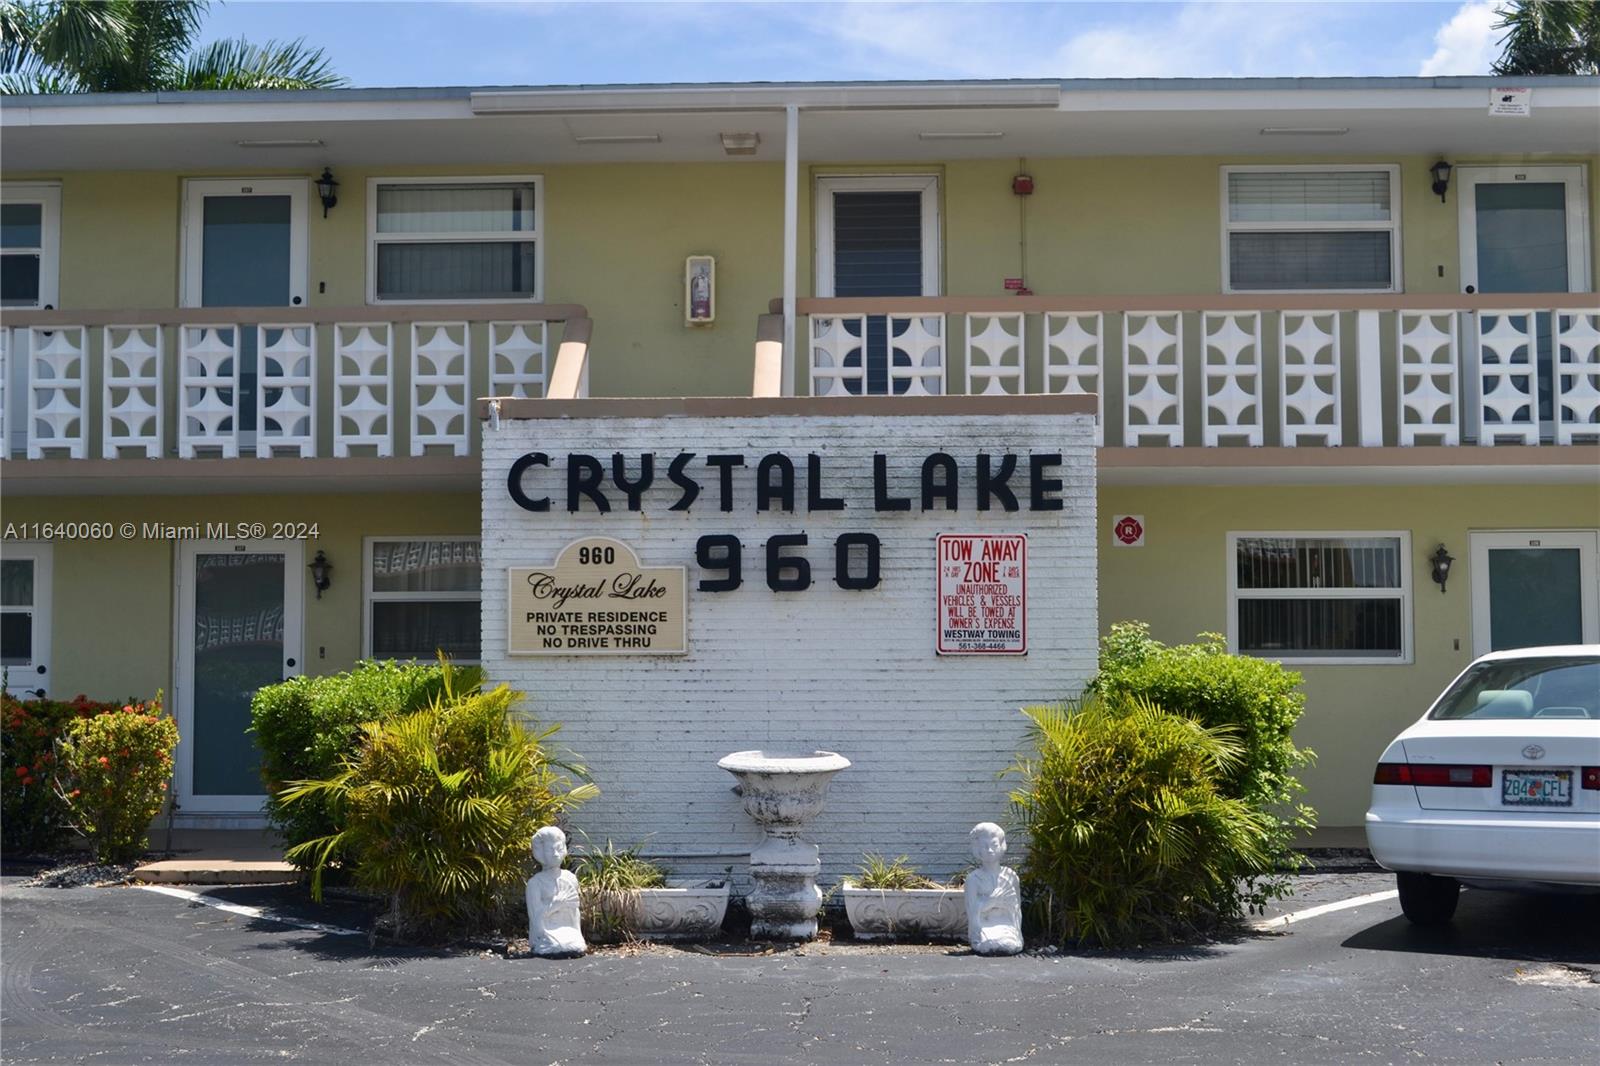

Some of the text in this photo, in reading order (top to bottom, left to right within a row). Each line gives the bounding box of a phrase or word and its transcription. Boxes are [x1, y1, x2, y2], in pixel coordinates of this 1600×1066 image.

[507, 452, 1064, 512] CRYSTAL LAKE
[1125, 526, 1133, 535] R
[579, 547, 615, 565] 960
[943, 540, 1020, 561] TOW AWAY
[696, 533, 881, 592] 960
[964, 562, 1000, 583] ZONE
[528, 572, 666, 609] Crystal Lake
[956, 584, 1007, 595] UNAUTHORIZED
[943, 595, 1020, 606] VEHICLES & VESSELS
[526, 612, 668, 622] PRIVATE RESIDENCE
[948, 607, 1015, 617] WILL BE TOWED AT
[984, 618, 1015, 629] EXPENSE
[537, 625, 657, 635] NO TRESPASSING
[944, 630, 1020, 639] WESTWAY TOWING
[543, 637, 651, 648] NO DRIVE THRU
[1543, 780, 1566, 797] CFL
